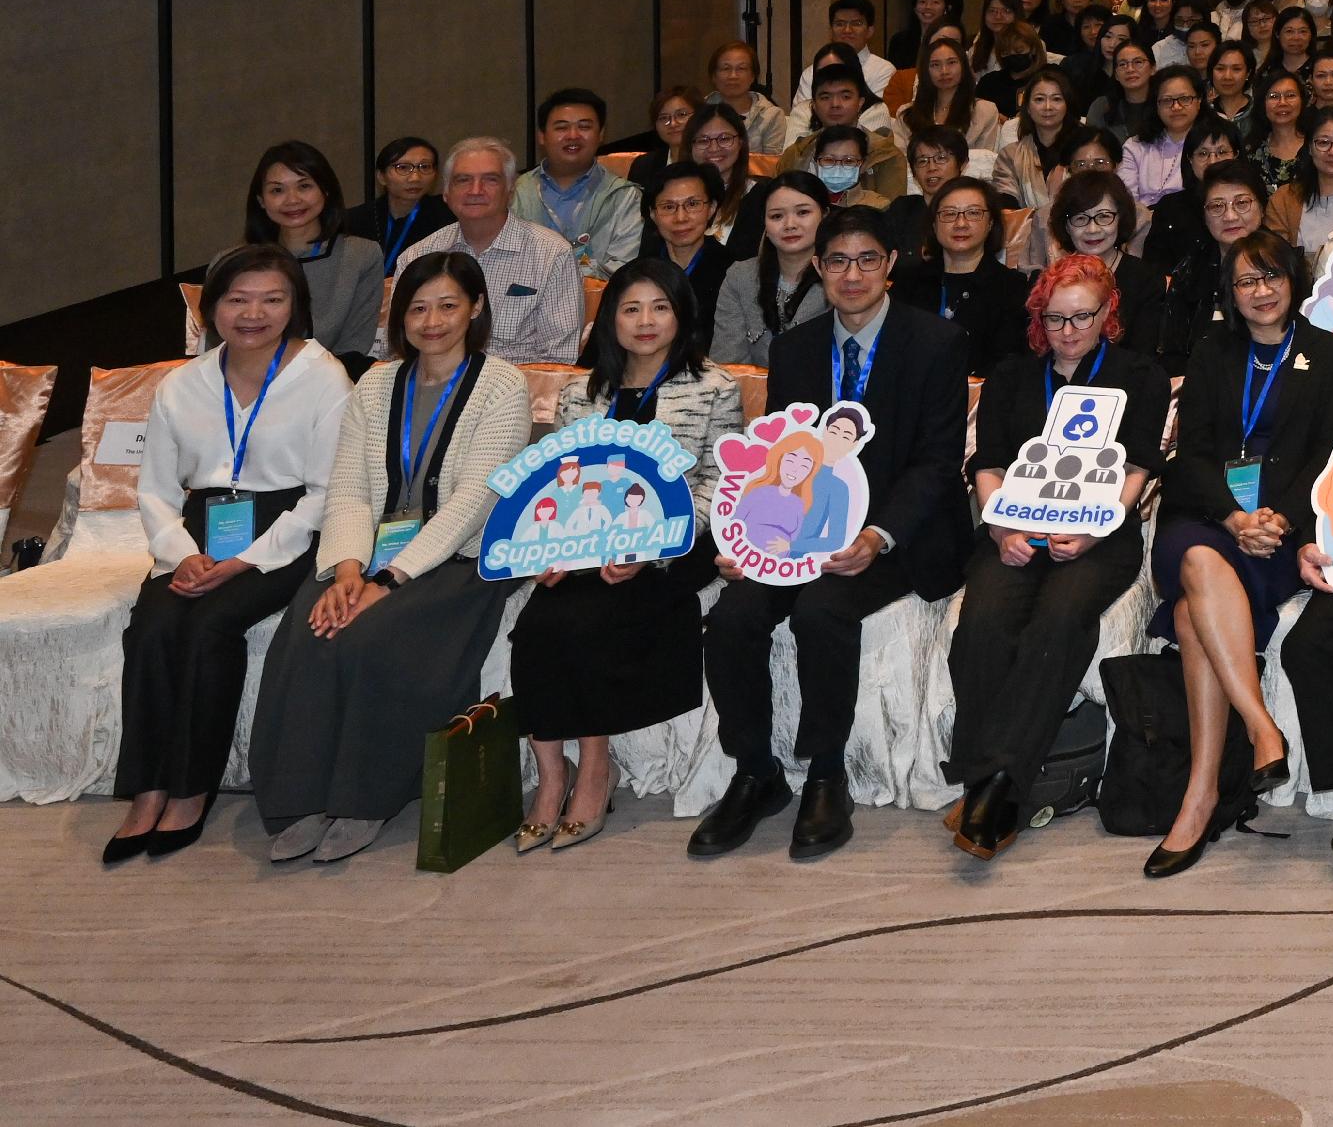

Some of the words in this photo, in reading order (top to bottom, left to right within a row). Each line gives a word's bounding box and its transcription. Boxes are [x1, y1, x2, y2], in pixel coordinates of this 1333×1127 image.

[492, 415, 691, 493] Breastfeeding
[716, 473, 746, 517] We
[993, 497, 1115, 526] Leadership
[491, 533, 599, 568] Support
[604, 530, 644, 554] for
[646, 523, 685, 547] All
[721, 522, 817, 578] Support
